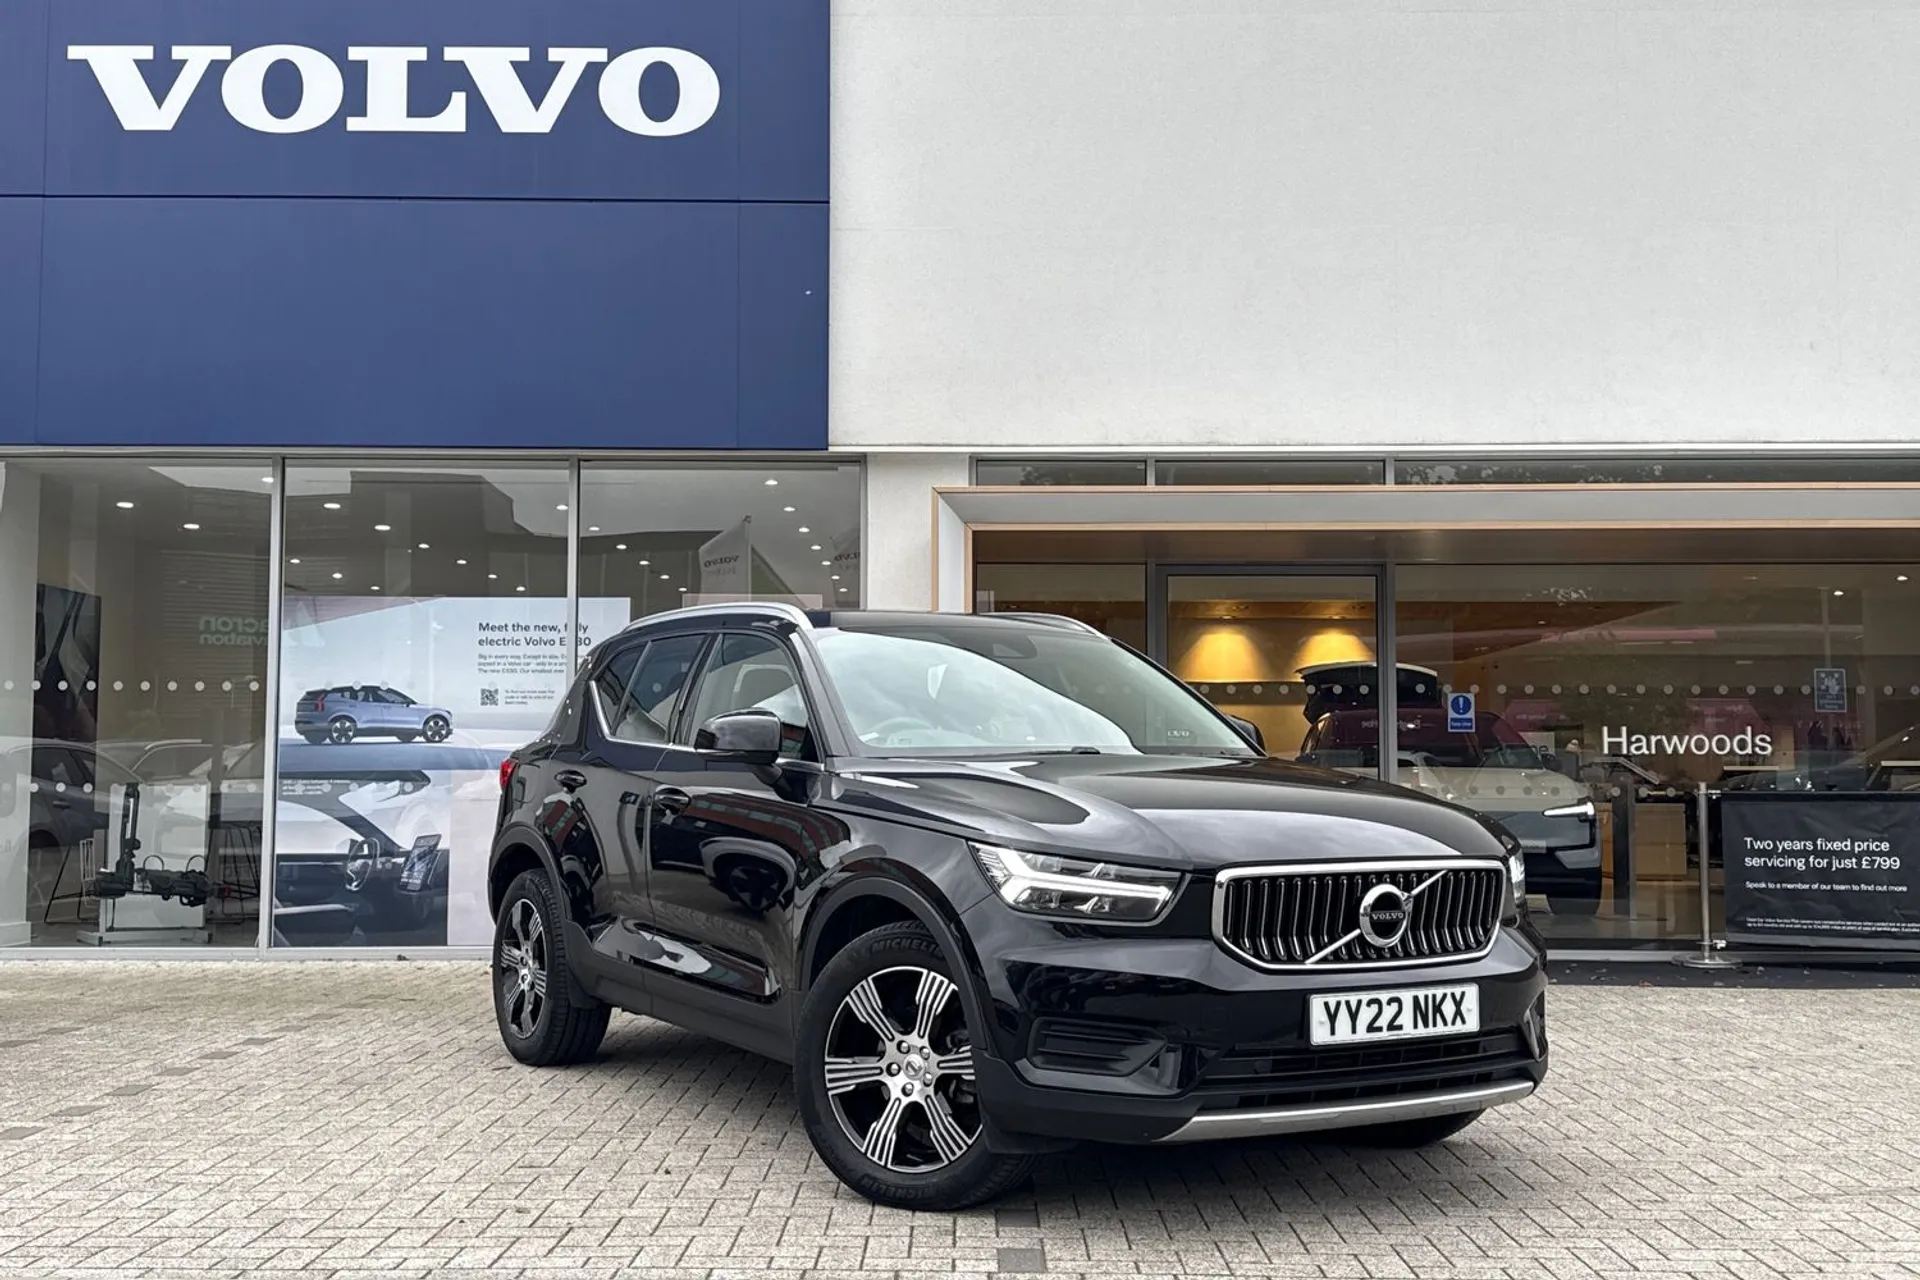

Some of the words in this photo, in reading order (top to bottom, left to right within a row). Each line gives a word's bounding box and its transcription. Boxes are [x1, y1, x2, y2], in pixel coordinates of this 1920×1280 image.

[67, 44, 720, 137] VOLVO
[478, 622, 509, 632] Meet
[511, 622, 531, 632] the
[533, 624, 561, 634] new,
[478, 637, 521, 646] electric
[524, 637, 556, 647] Volvo
[1602, 725, 1773, 756] Harwoods
[1744, 837, 1774, 850] Two
[1776, 840, 1814, 853] years
[1816, 838, 1851, 851] fixed
[1854, 838, 1891, 854] price
[1744, 855, 1806, 871] servicing
[1808, 855, 1829, 868] for
[1831, 856, 1858, 872] just
[1861, 856, 1901, 870] £799
[1745, 881, 1767, 890] Speak
[1782, 882, 1810, 890] member
[1861, 884, 1875, 892] find
[1371, 912, 1404, 920] VOLVO
[1323, 997, 1403, 1036] YY22
[1412, 991, 1466, 1029] NKX
